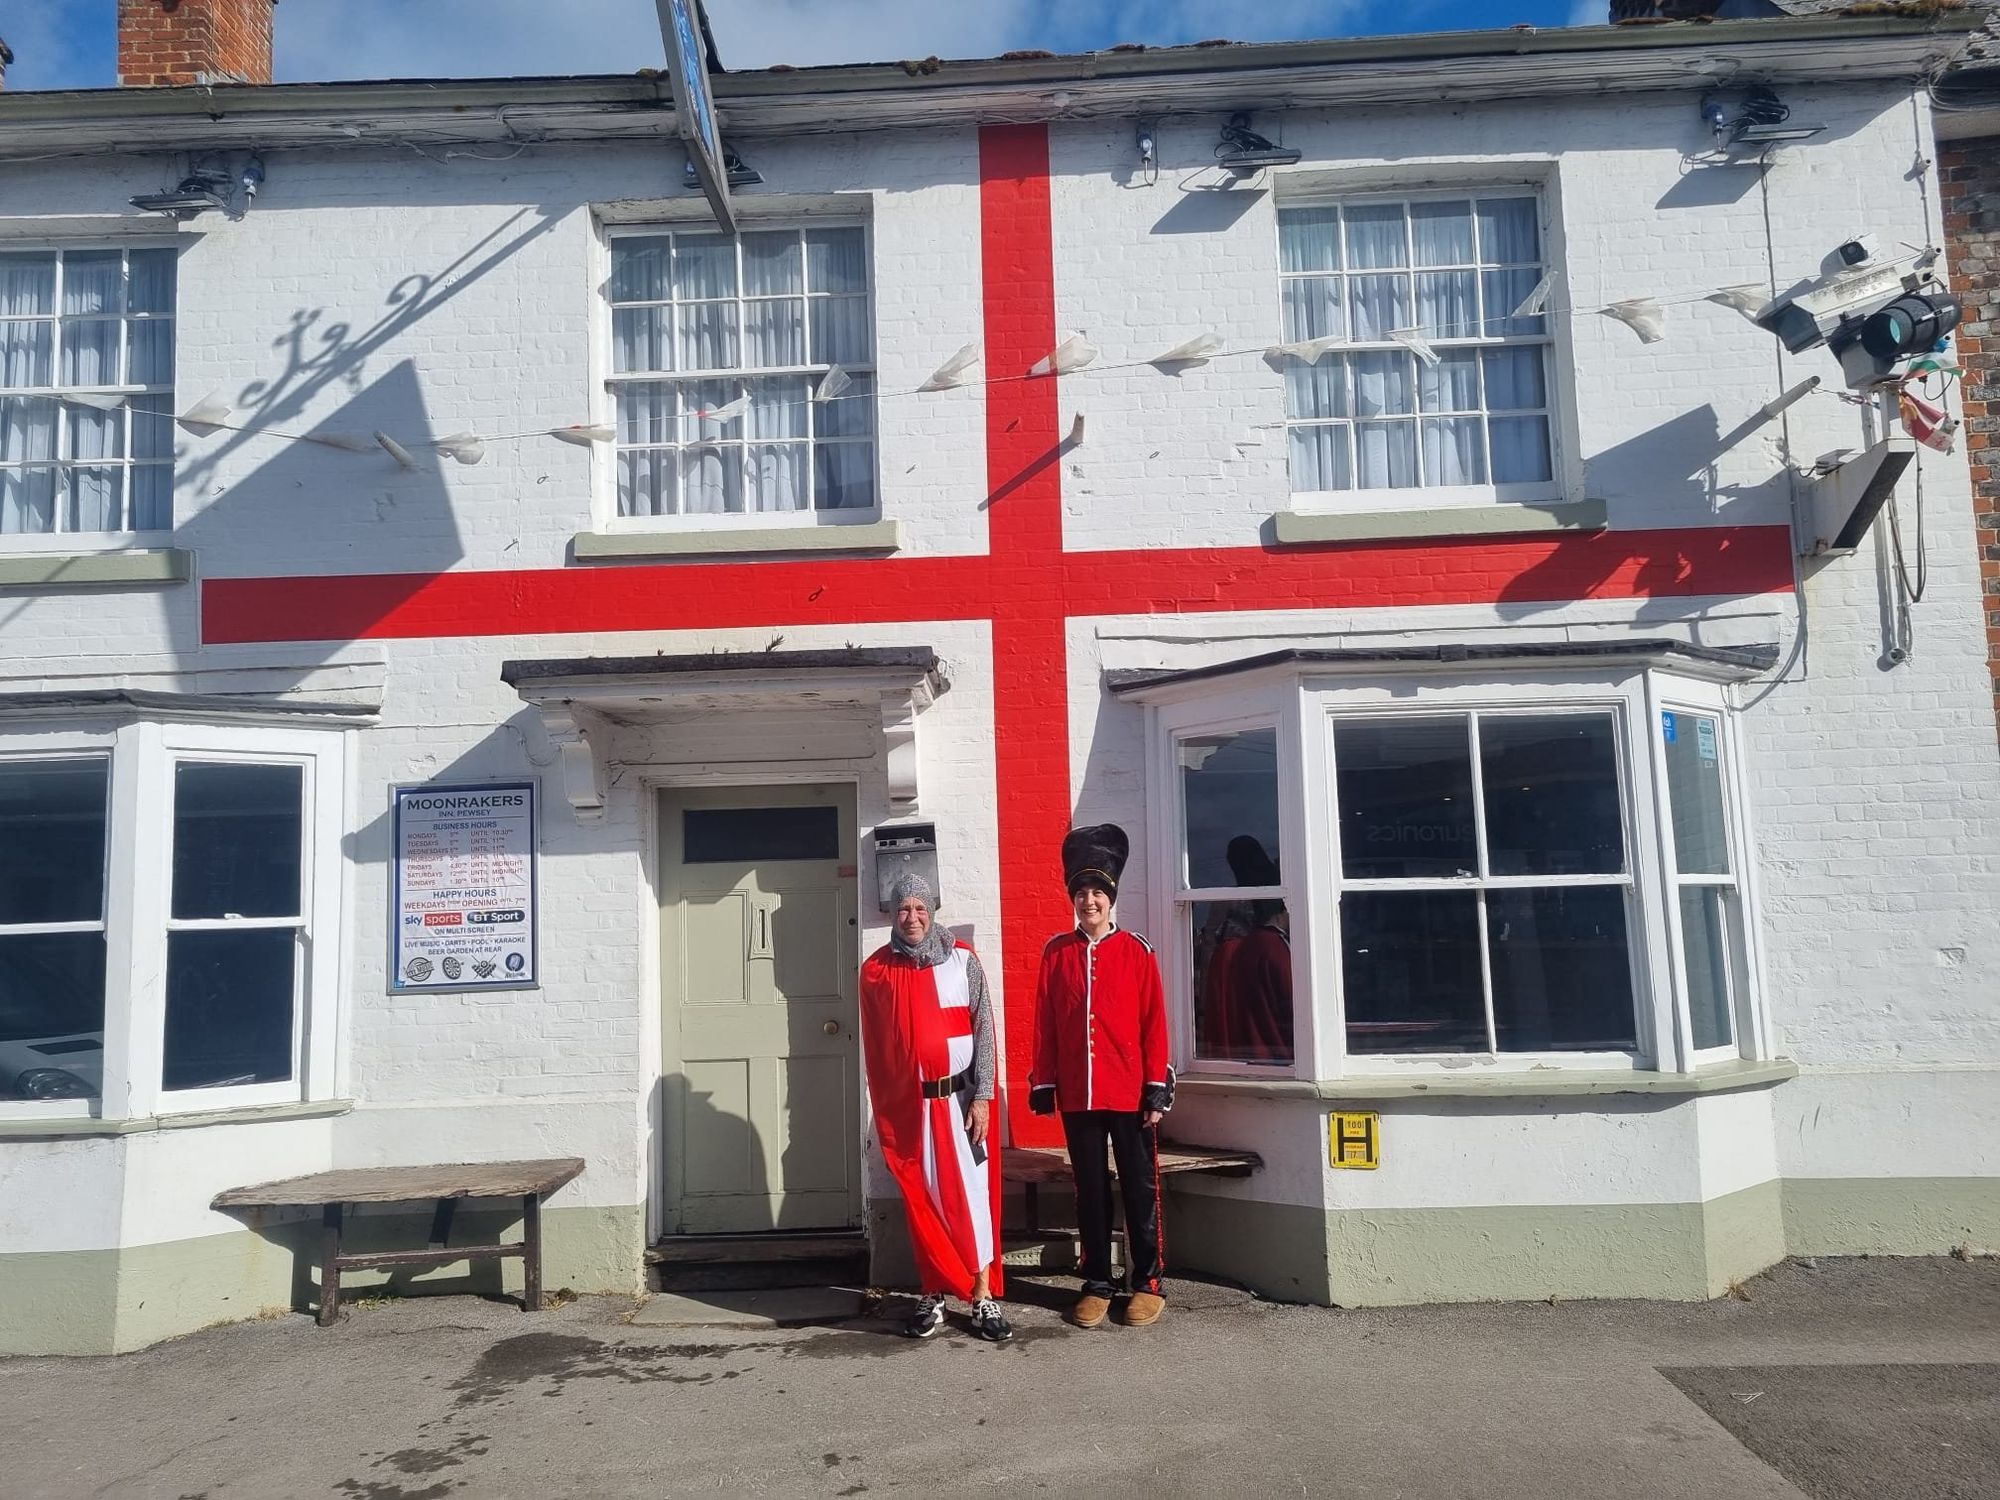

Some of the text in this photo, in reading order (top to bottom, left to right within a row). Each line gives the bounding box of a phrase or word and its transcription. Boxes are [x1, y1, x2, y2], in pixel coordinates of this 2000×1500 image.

[407, 796, 523, 810] MOONRAKERS
[433, 889, 496, 899] HAPPY HOURS
[462, 899, 498, 907] OPENING
[405, 914, 461, 925] sky sports
[473, 912, 519, 922] BT Sport
[428, 947, 445, 955] BEER
